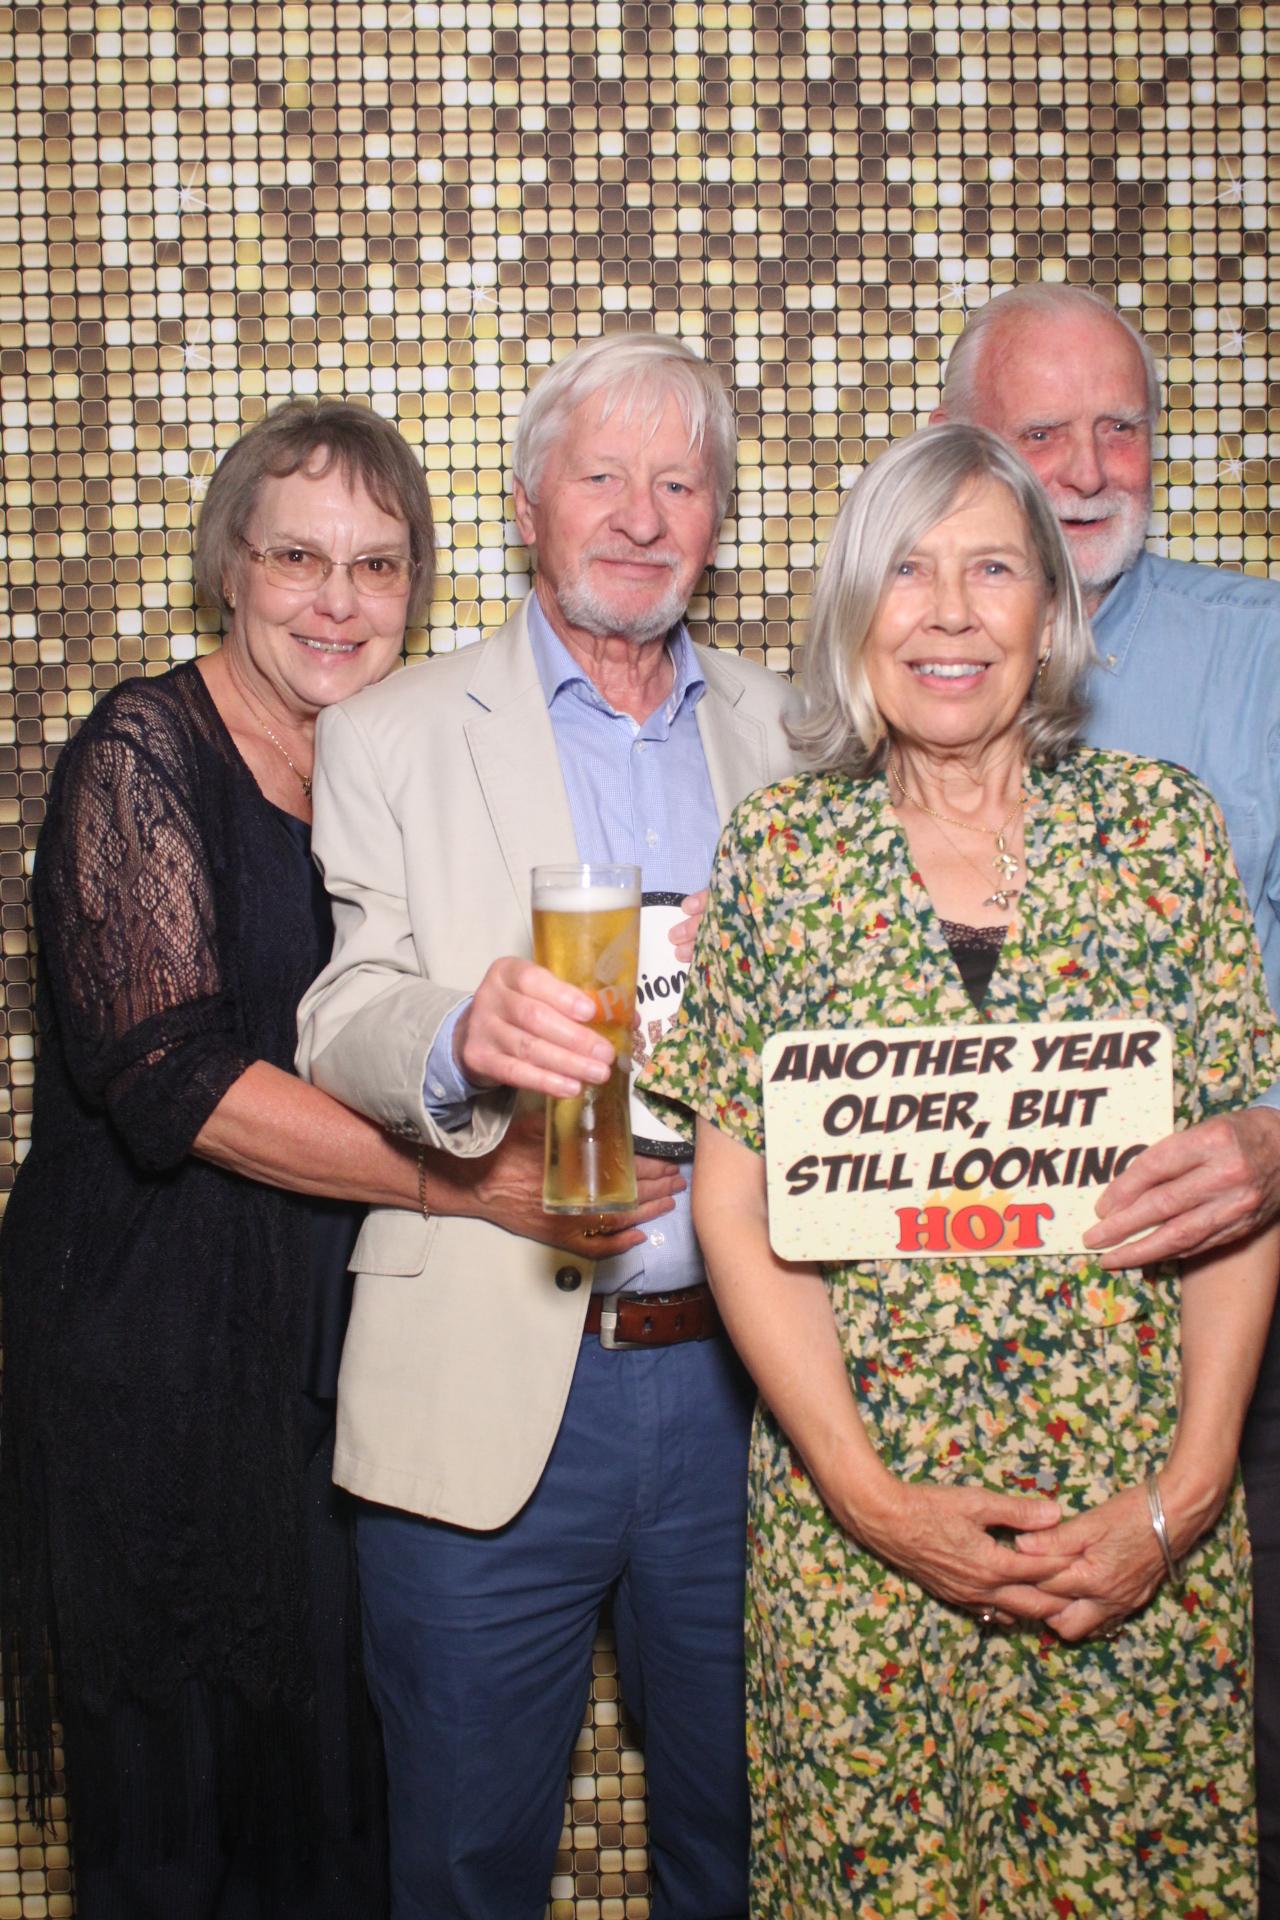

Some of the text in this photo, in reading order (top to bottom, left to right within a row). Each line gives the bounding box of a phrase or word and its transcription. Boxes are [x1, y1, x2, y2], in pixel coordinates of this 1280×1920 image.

[769, 1030, 1161, 1082] ANOTHER YEAR
[822, 1087, 1109, 1139] OLDER, BUT
[785, 1153, 914, 1196] STILL
[895, 1202, 1055, 1252] HOT
